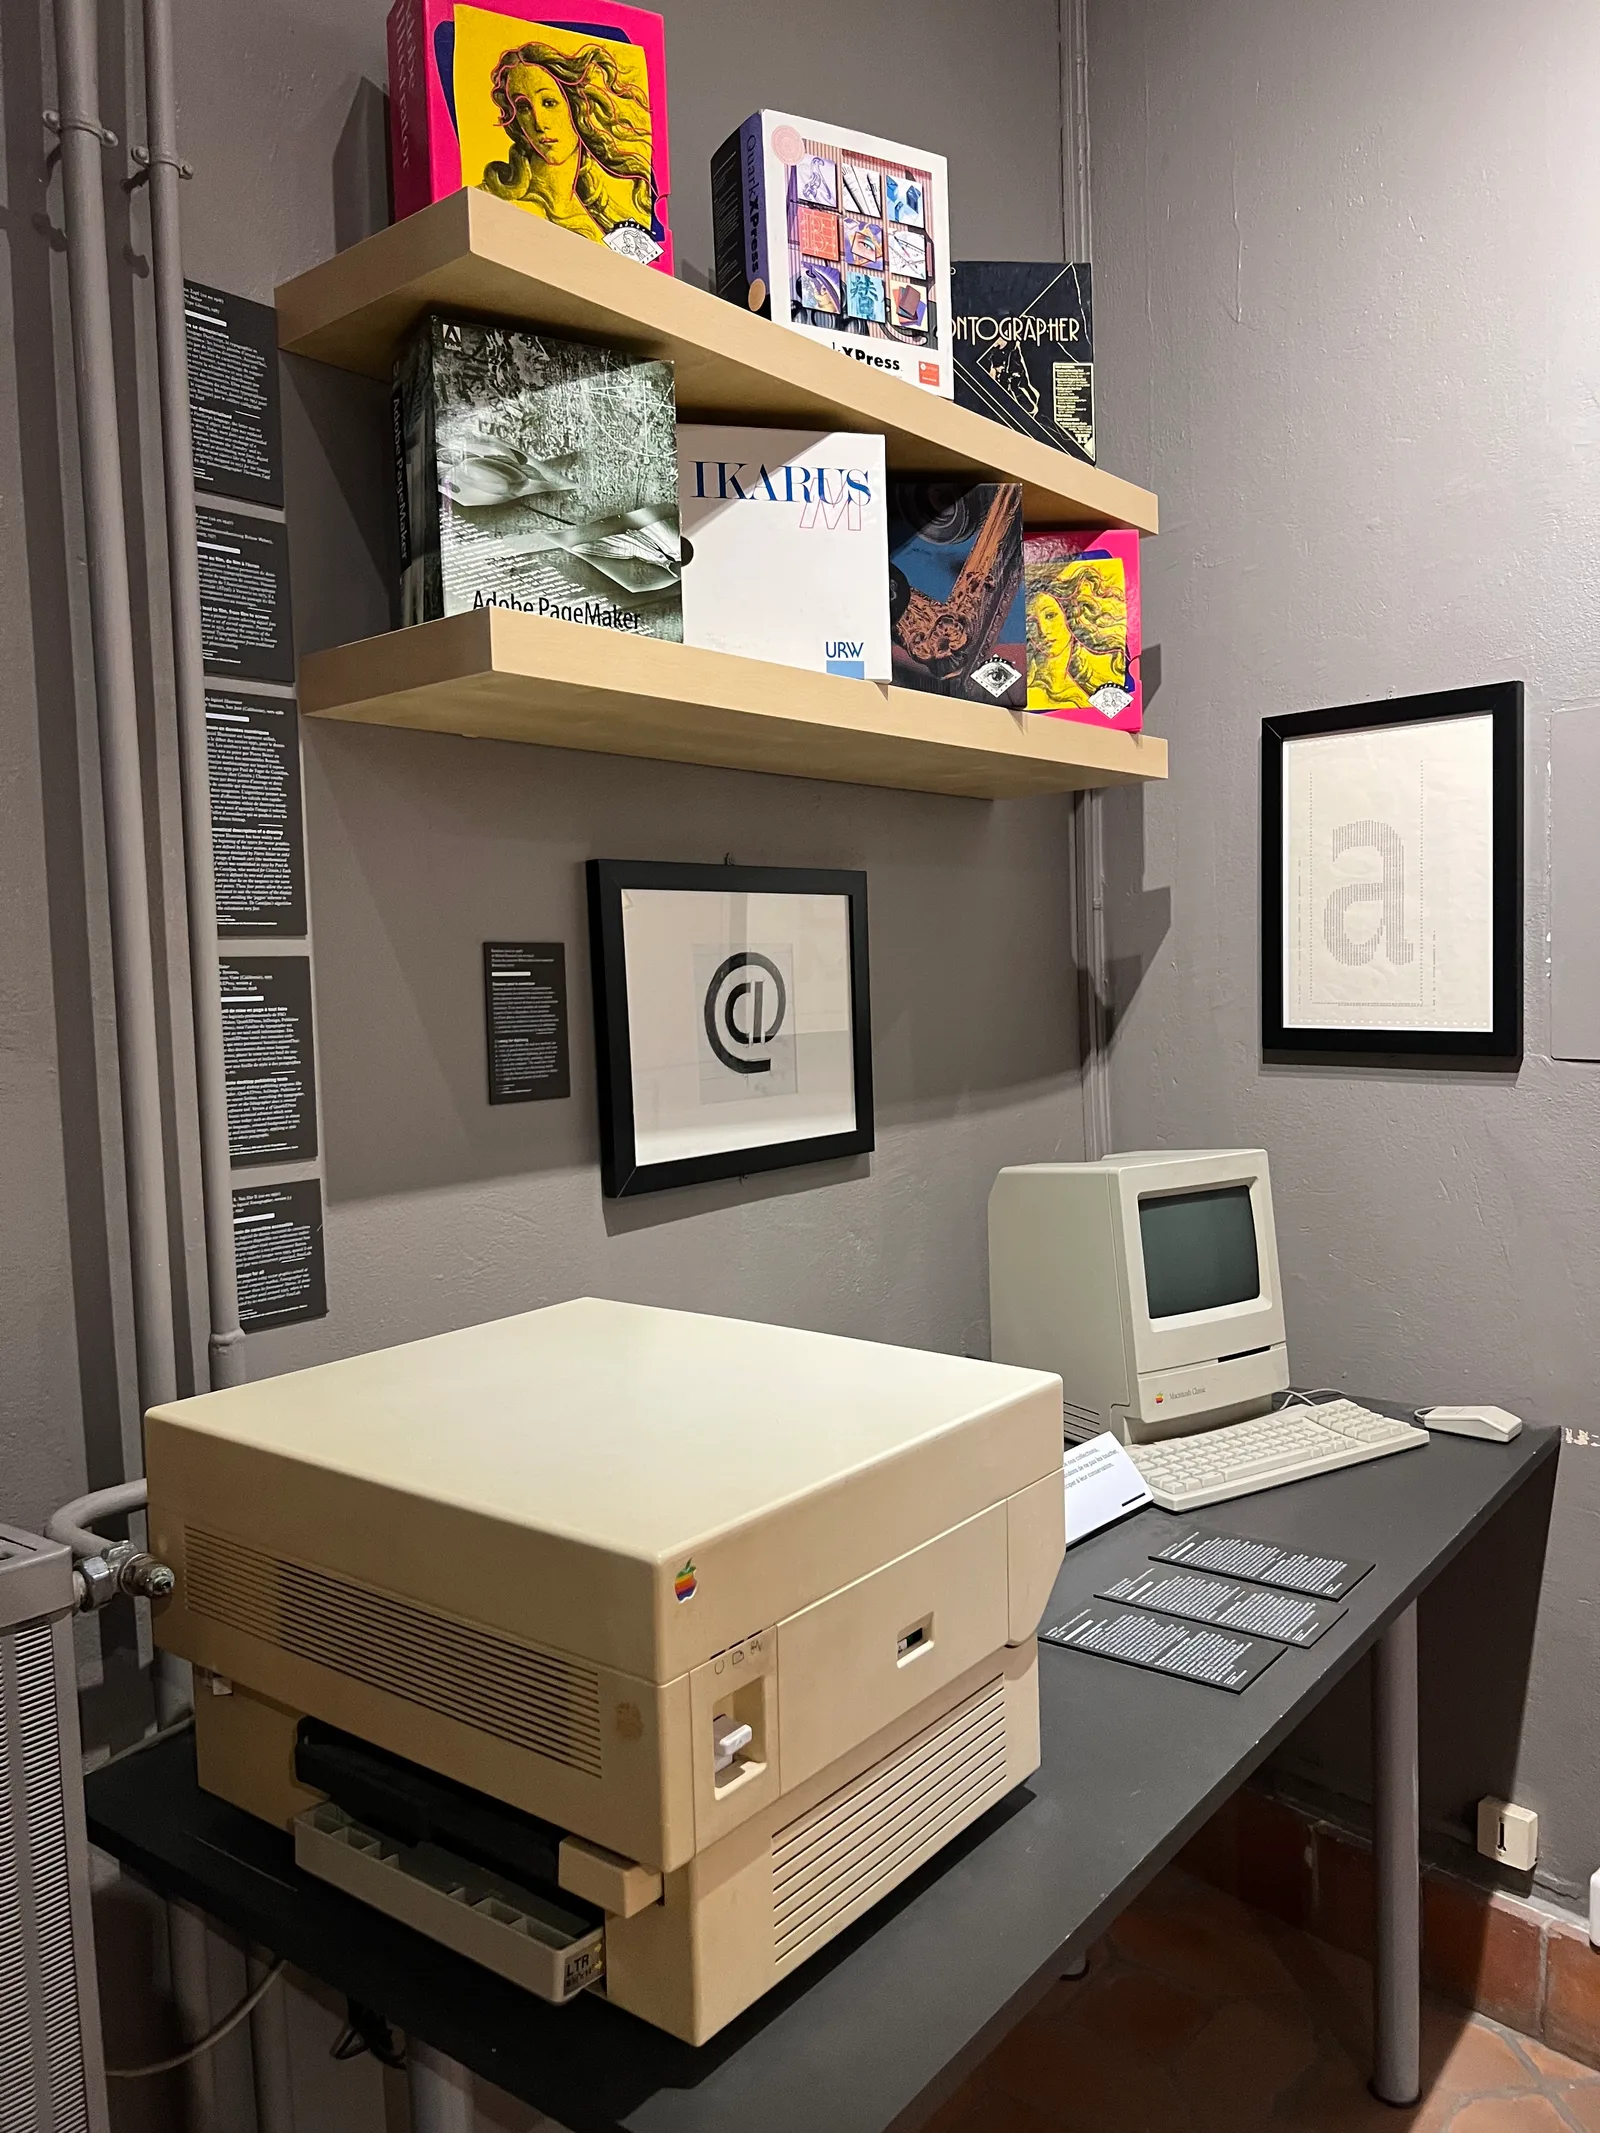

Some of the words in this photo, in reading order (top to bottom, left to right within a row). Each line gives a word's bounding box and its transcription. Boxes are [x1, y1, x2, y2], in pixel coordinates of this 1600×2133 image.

[396, 4, 410, 168] Illustrator
[746, 135, 760, 273] QuarkXPress
[951, 316, 1080, 346] NTOGRAPHER
[832, 342, 900, 370] XPress
[688, 460, 872, 506] IKARUS
[539, 597, 641, 630] PageMaker
[826, 642, 864, 658] URW
[566, 1954, 590, 1976] LTR
